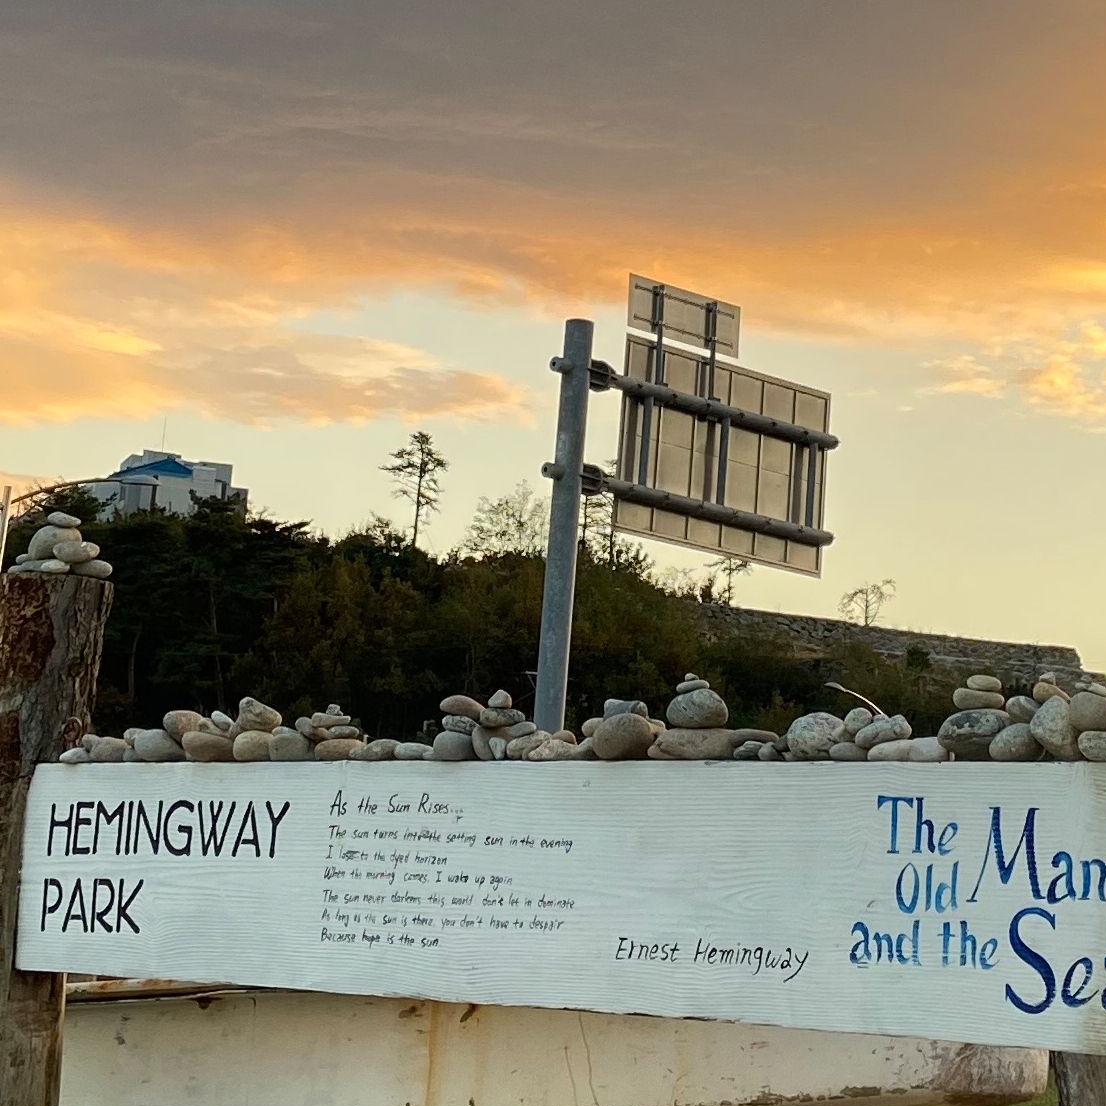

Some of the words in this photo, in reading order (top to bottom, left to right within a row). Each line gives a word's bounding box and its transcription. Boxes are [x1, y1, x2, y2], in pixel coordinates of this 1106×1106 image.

[329, 789, 348, 818] As
[357, 795, 378, 815] the
[388, 793, 410, 814] Sun
[47, 799, 291, 858] HEMINGWAY
[329, 825, 347, 841] The
[352, 829, 369, 840] sun
[373, 829, 399, 840] turns
[483, 836, 504, 847] sun
[509, 835, 518, 846] in
[540, 838, 574, 854] evening
[877, 795, 959, 854] The
[326, 844, 334, 860] I
[374, 850, 386, 862] the
[390, 848, 411, 870] dyed
[414, 850, 448, 866] horizon
[966, 806, 1106, 903] Man
[323, 865, 346, 881] When
[366, 868, 396, 886] morning
[435, 870, 443, 883] I
[447, 870, 469, 884] wake
[474, 875, 486, 892] up
[489, 874, 513, 892] again
[895, 861, 959, 914] Old
[40, 877, 145, 934] PARK
[323, 888, 339, 903] The
[343, 892, 360, 905] sun
[363, 893, 387, 904] never
[427, 891, 445, 908] this
[481, 893, 504, 908] don't
[320, 926, 357, 943] Because
[361, 927, 381, 949] hope
[386, 932, 395, 946] is
[398, 932, 415, 948] the
[420, 936, 440, 949] sun
[321, 907, 331, 921] As
[335, 908, 350, 928] long
[353, 912, 362, 924] as
[382, 914, 398, 926] sun
[400, 913, 409, 928] is
[441, 918, 457, 931] you
[459, 913, 483, 928] don't
[489, 914, 510, 930] have
[512, 916, 525, 929] to
[528, 914, 565, 934] despair
[614, 936, 682, 962] Ernest
[692, 937, 810, 983] Hemingway
[849, 918, 923, 969] and
[941, 924, 1001, 970] the
